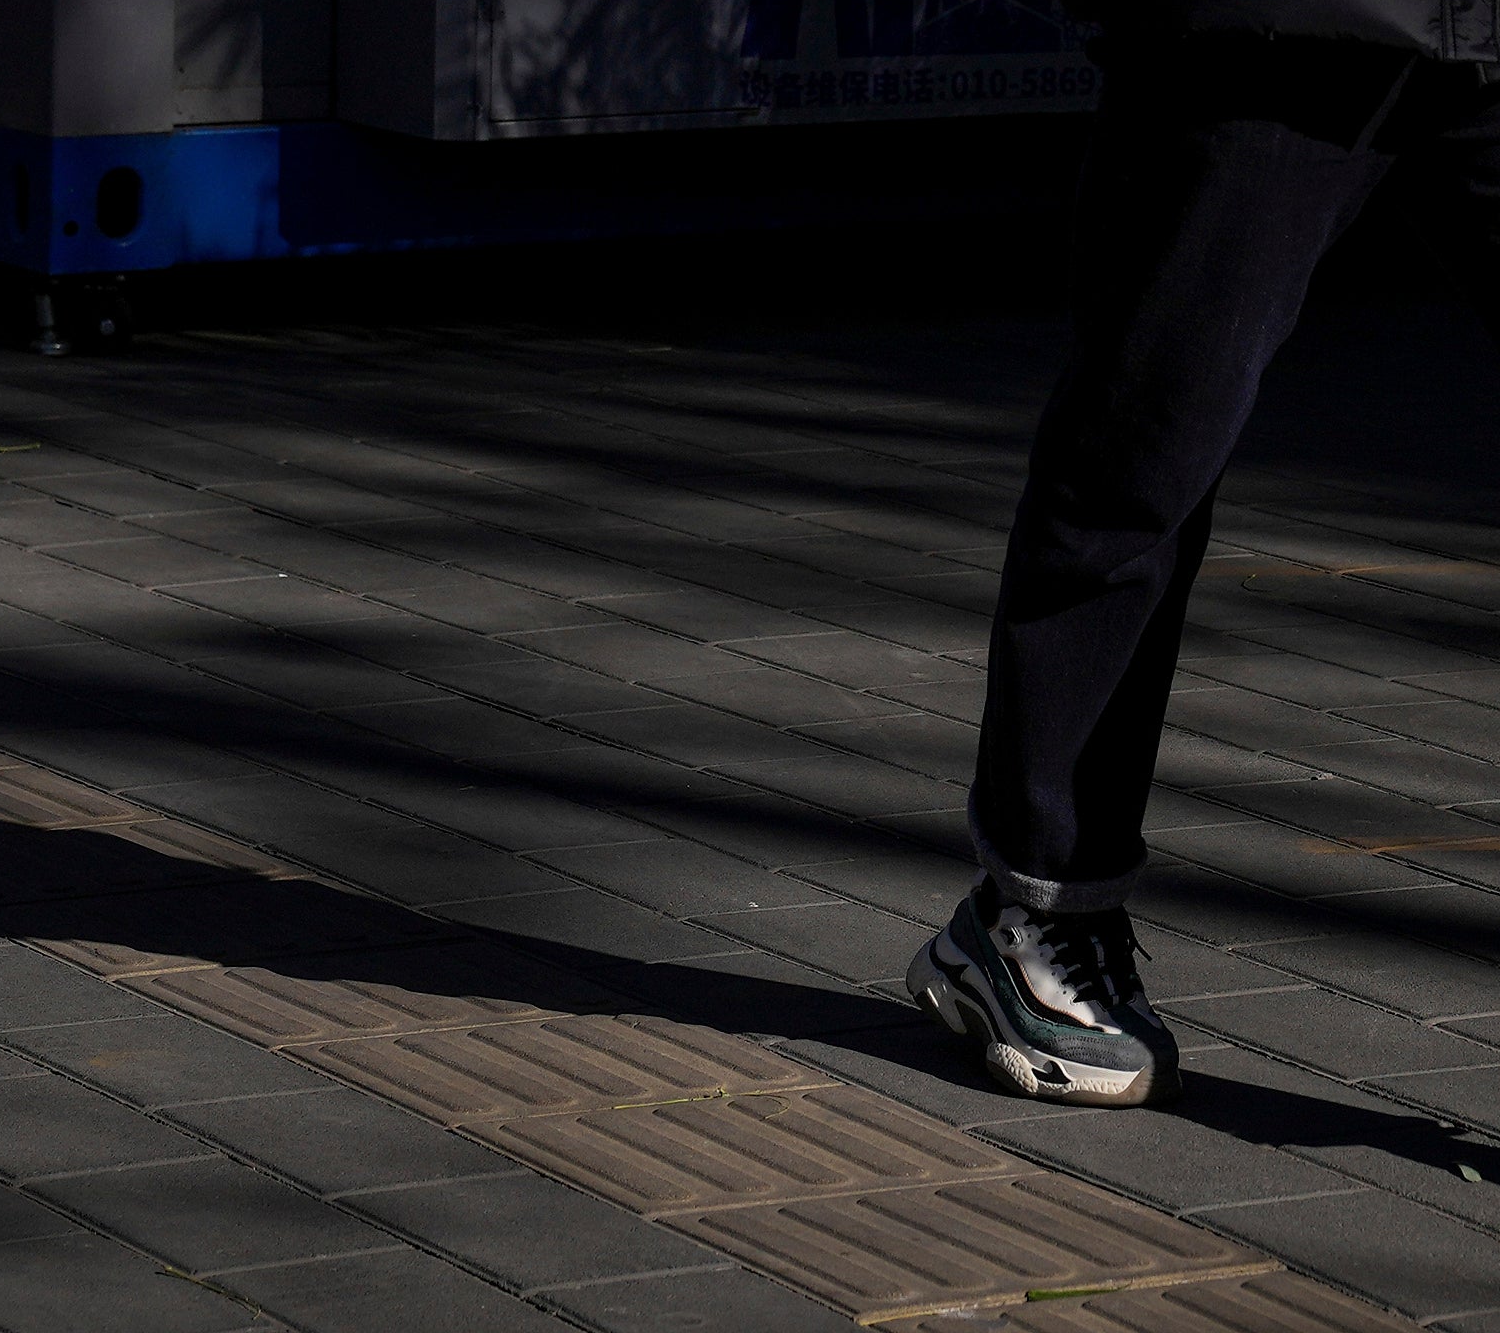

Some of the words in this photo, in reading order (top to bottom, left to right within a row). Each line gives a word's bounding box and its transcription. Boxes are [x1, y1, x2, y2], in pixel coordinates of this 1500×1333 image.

[739, 66, 1107, 109] 设备维保电话:010-5869
